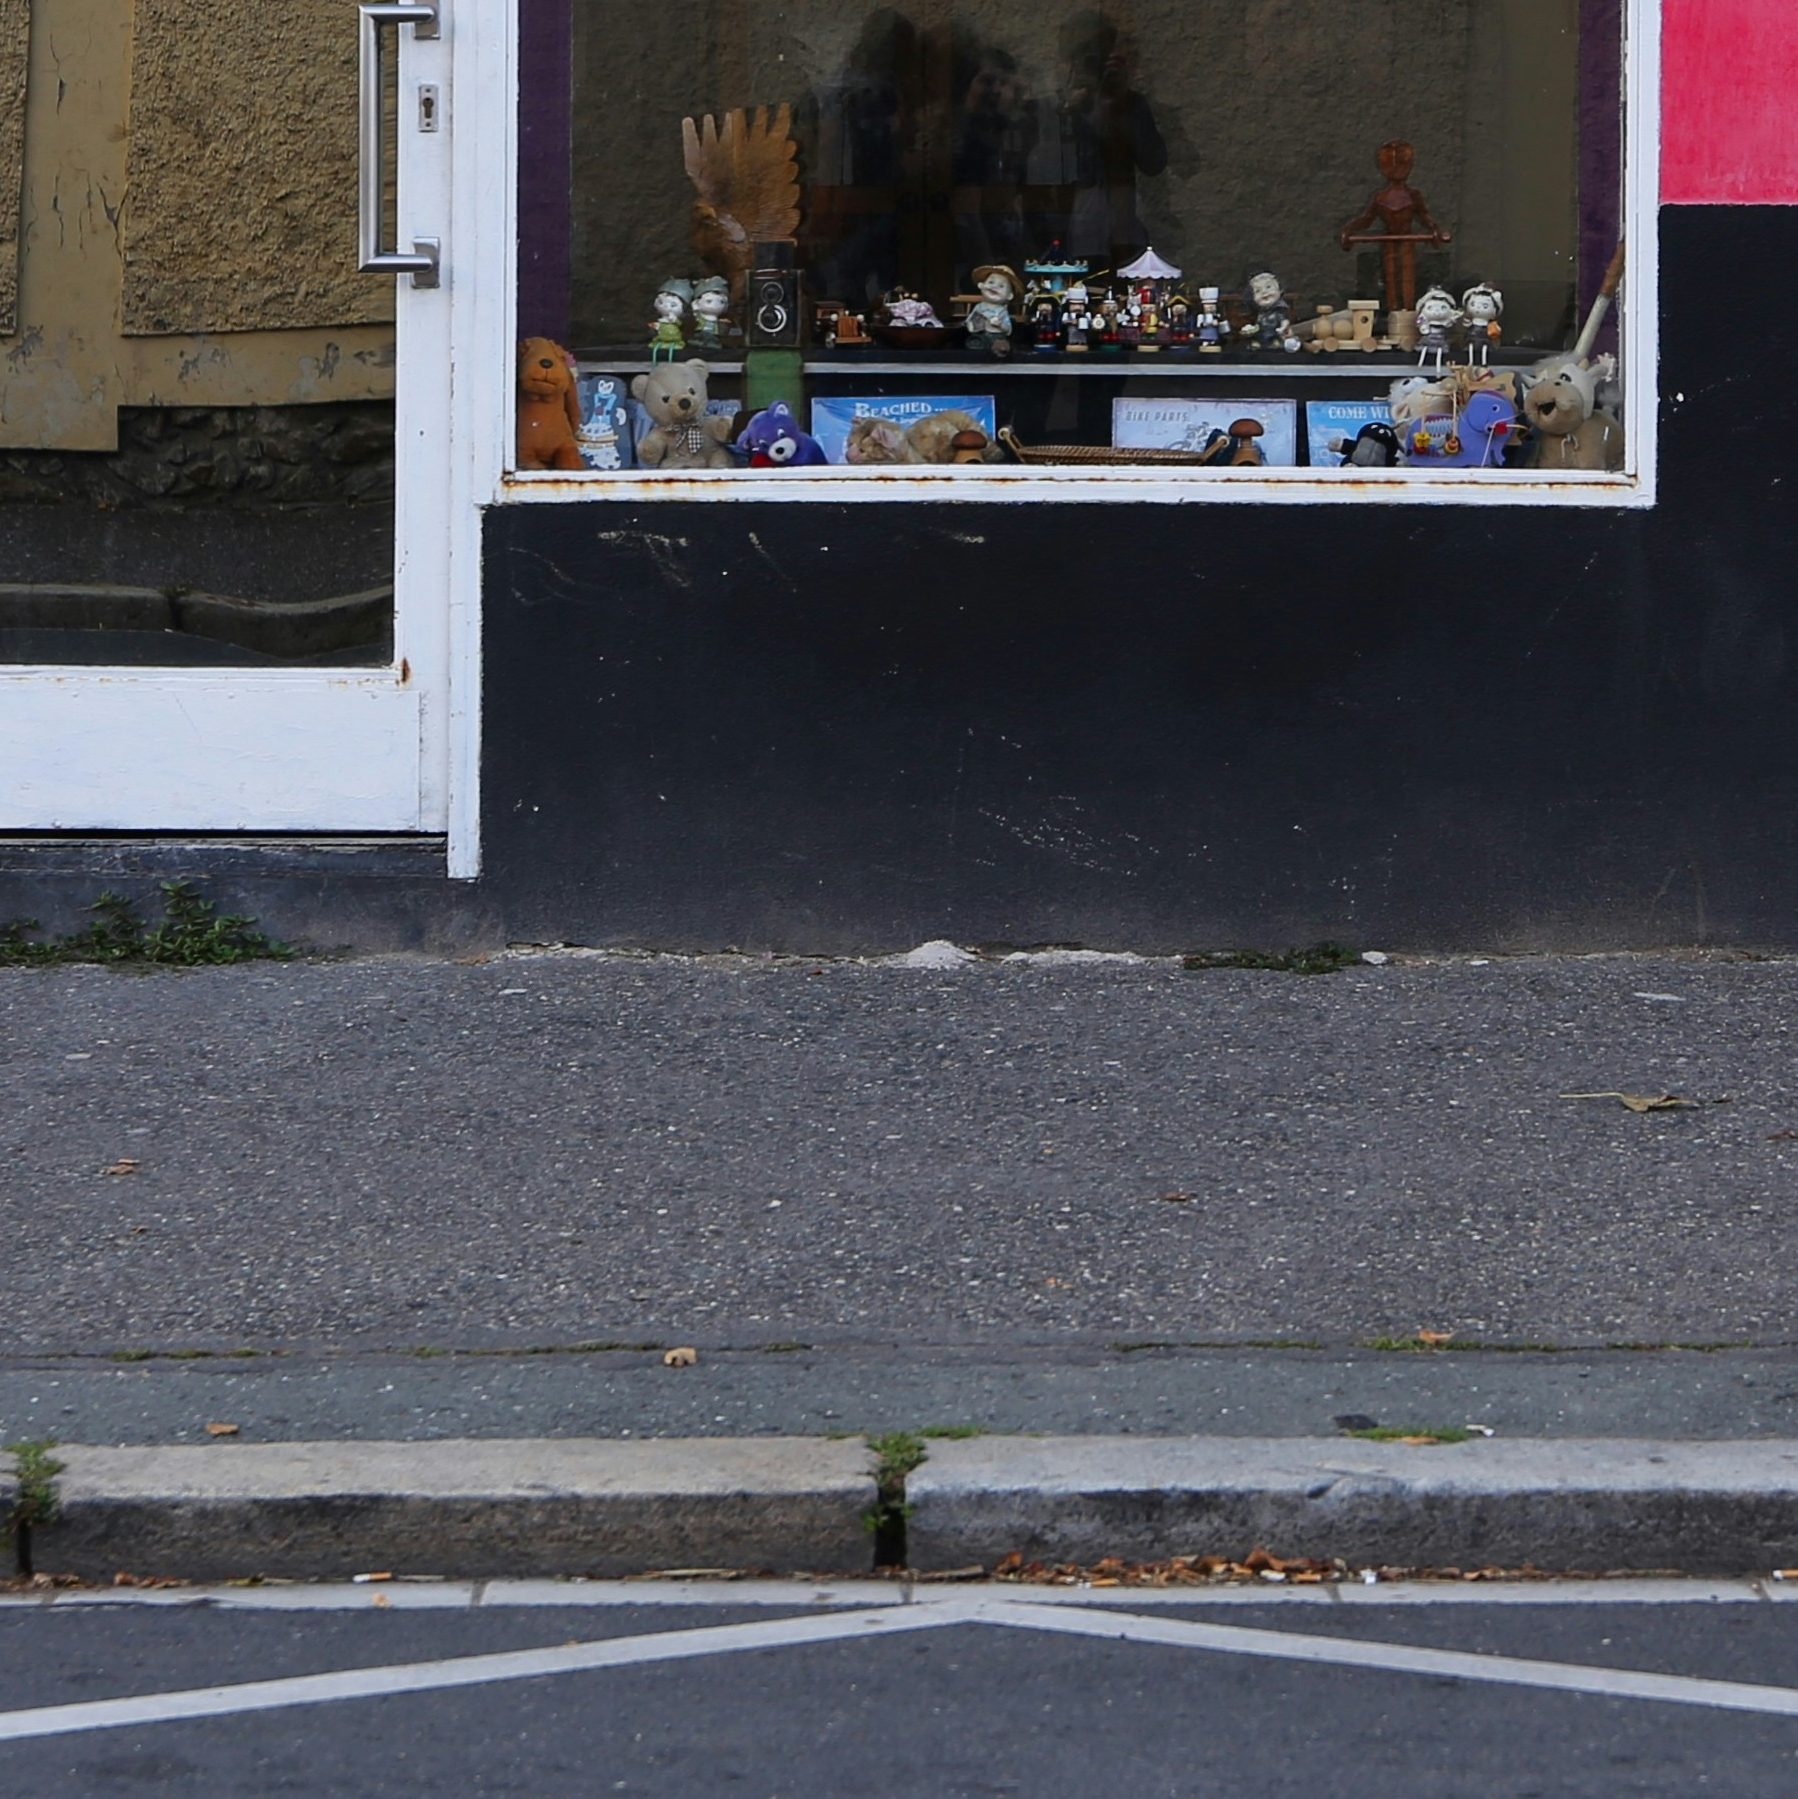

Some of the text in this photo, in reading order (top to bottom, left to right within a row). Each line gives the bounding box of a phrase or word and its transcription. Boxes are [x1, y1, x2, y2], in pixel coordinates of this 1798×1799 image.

[1126, 411, 1188, 422] BIKE PARTS
[1328, 406, 1391, 419] COME WI
